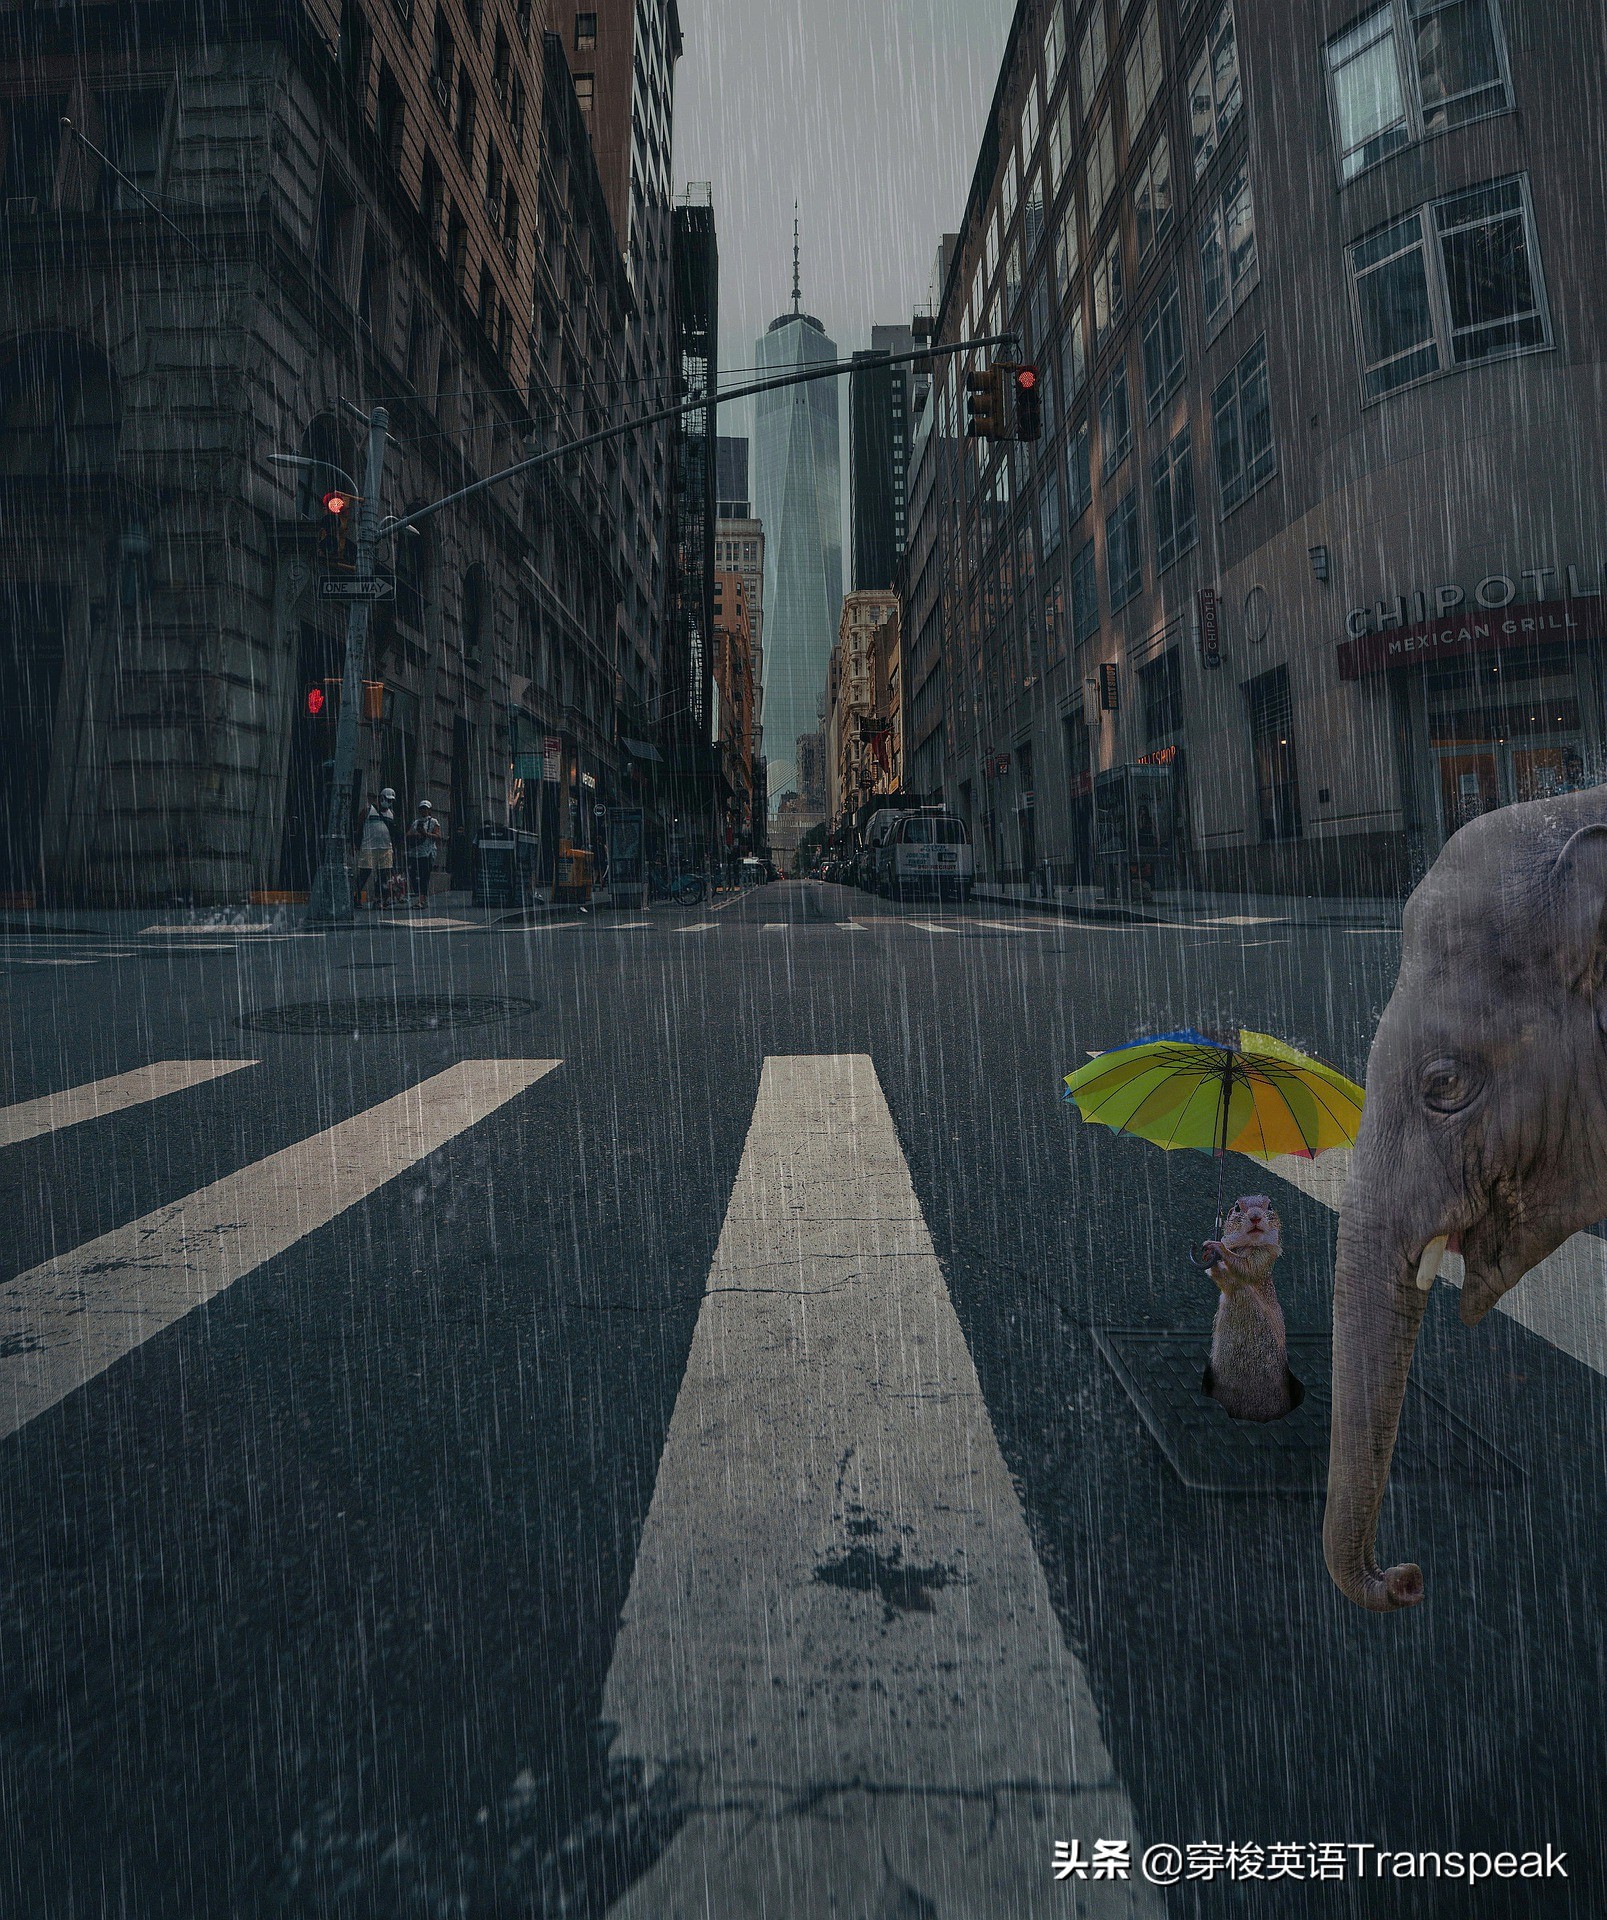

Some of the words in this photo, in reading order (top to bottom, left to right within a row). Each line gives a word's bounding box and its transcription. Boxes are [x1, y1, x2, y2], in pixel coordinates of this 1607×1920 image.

[325, 583, 348, 593] ONE
[361, 583, 385, 593] WAY
[1344, 563, 1607, 641] CHIPOTL
[1204, 591, 1217, 650] CHIPOTLE
[1388, 623, 1490, 655] MEXICAN
[1501, 613, 1579, 635] GRILL
